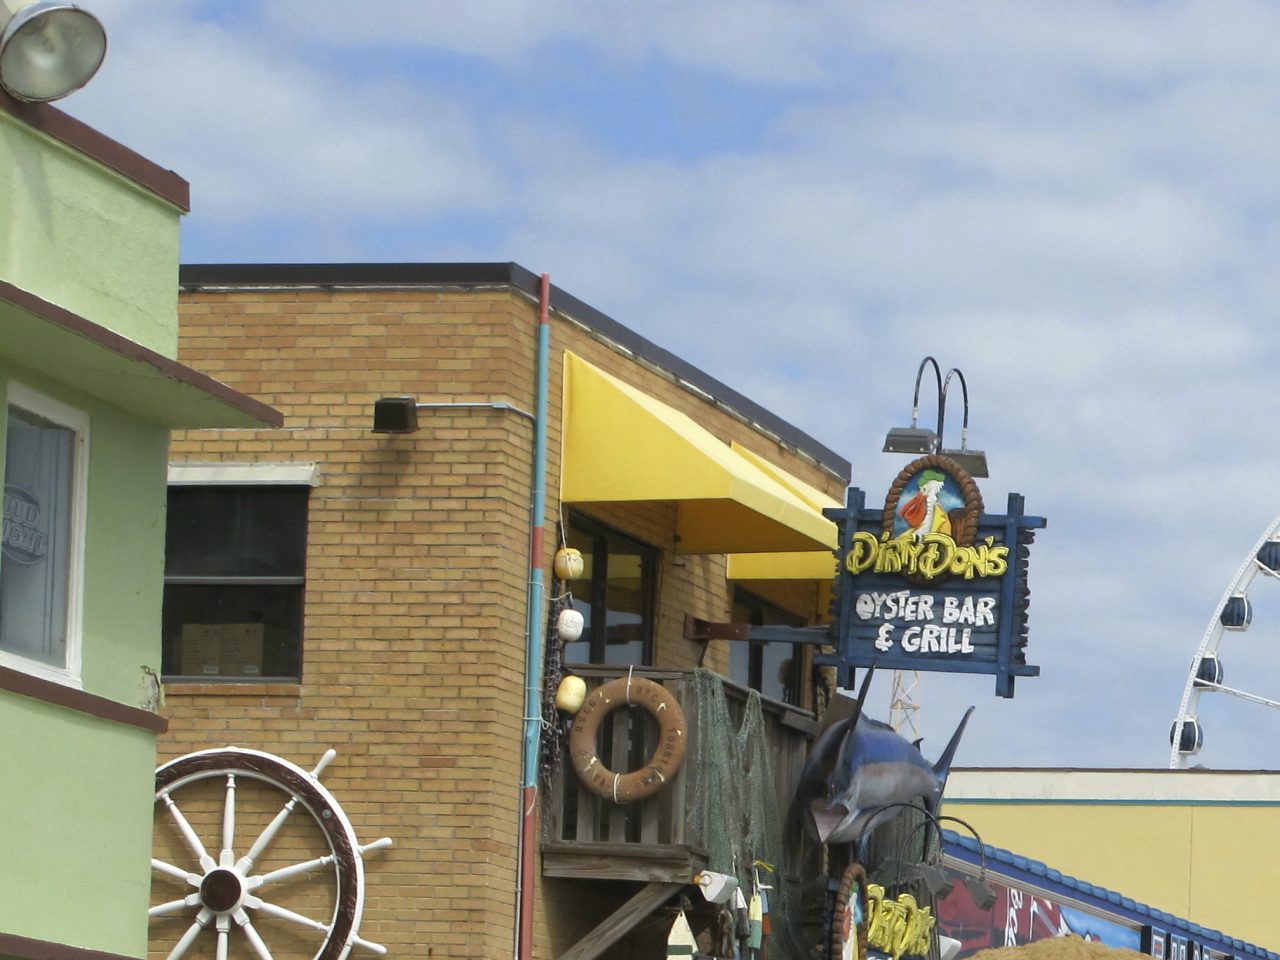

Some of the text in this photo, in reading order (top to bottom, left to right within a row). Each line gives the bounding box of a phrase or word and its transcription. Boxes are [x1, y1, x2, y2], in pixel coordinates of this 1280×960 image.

[3, 520, 47, 555] IGHT
[856, 590, 996, 626] OYSTER BAR
[875, 622, 975, 654] & GRILL
